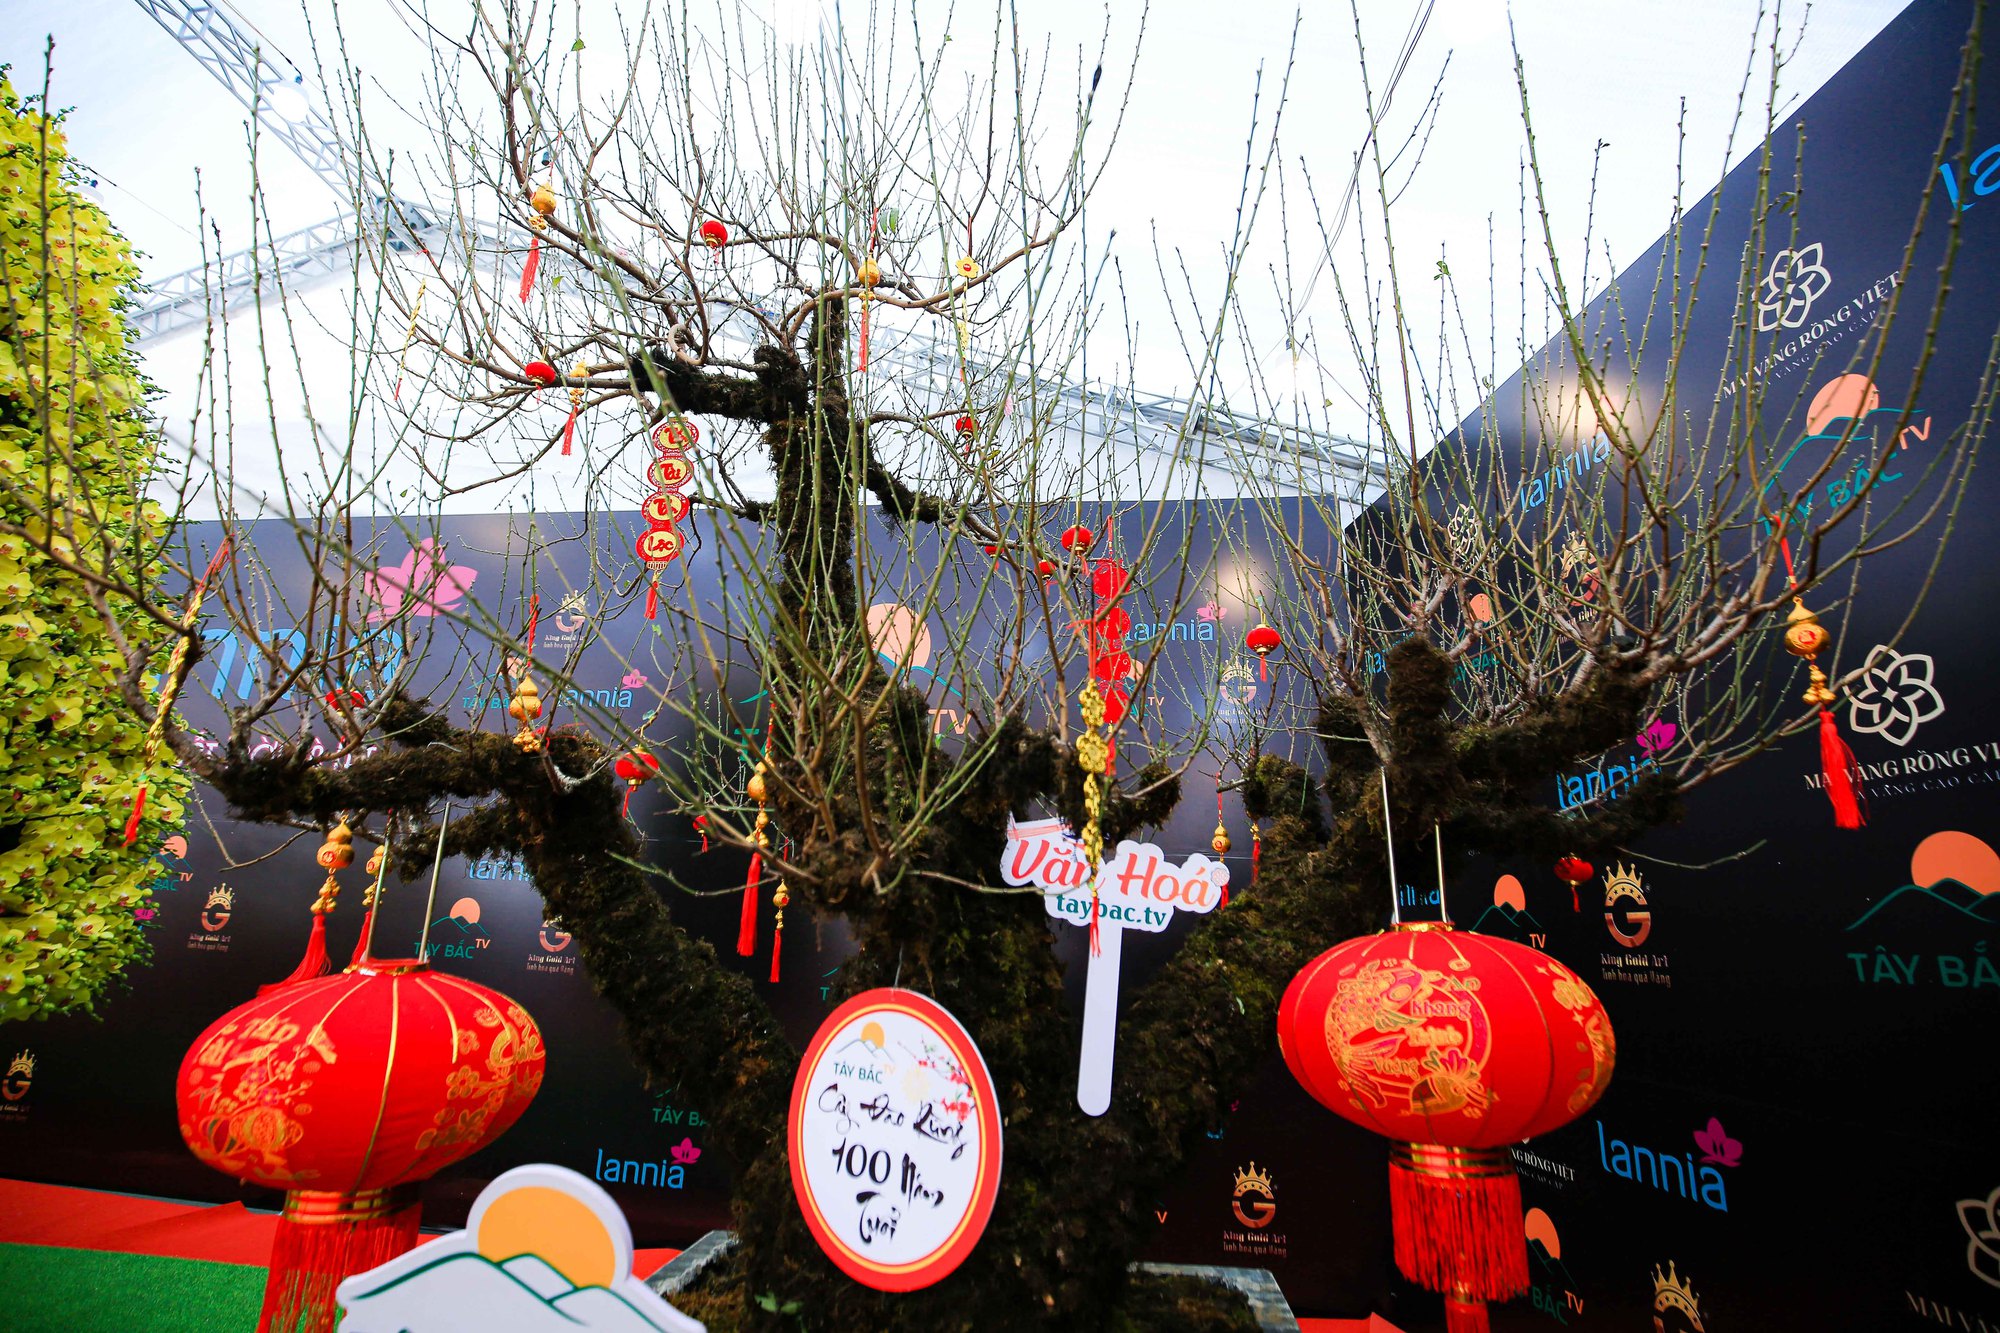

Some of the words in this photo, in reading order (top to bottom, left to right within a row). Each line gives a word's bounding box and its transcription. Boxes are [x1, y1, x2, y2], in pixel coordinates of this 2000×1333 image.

[1799, 305, 1851, 348] RỒNG
[1900, 416, 1931, 450] TV
[1902, 748, 1971, 774] RỒNG
[180, 872, 194, 882] TV
[1117, 852, 1216, 908] Hoá
[444, 939, 475, 959] BẮC
[475, 938, 491, 949] TV
[1529, 933, 1546, 949] TV
[1625, 954, 1648, 967] Gold
[1846, 944, 1921, 985] TÂY
[833, 1060, 855, 1078] TÂY
[858, 1063, 883, 1084] BẮC
[652, 1105, 684, 1125] TÂY
[595, 1147, 686, 1190] lannia
[832, 1137, 891, 1184] 100
[1596, 1120, 1728, 1213] lannia
[1564, 1289, 1584, 1315] TV
